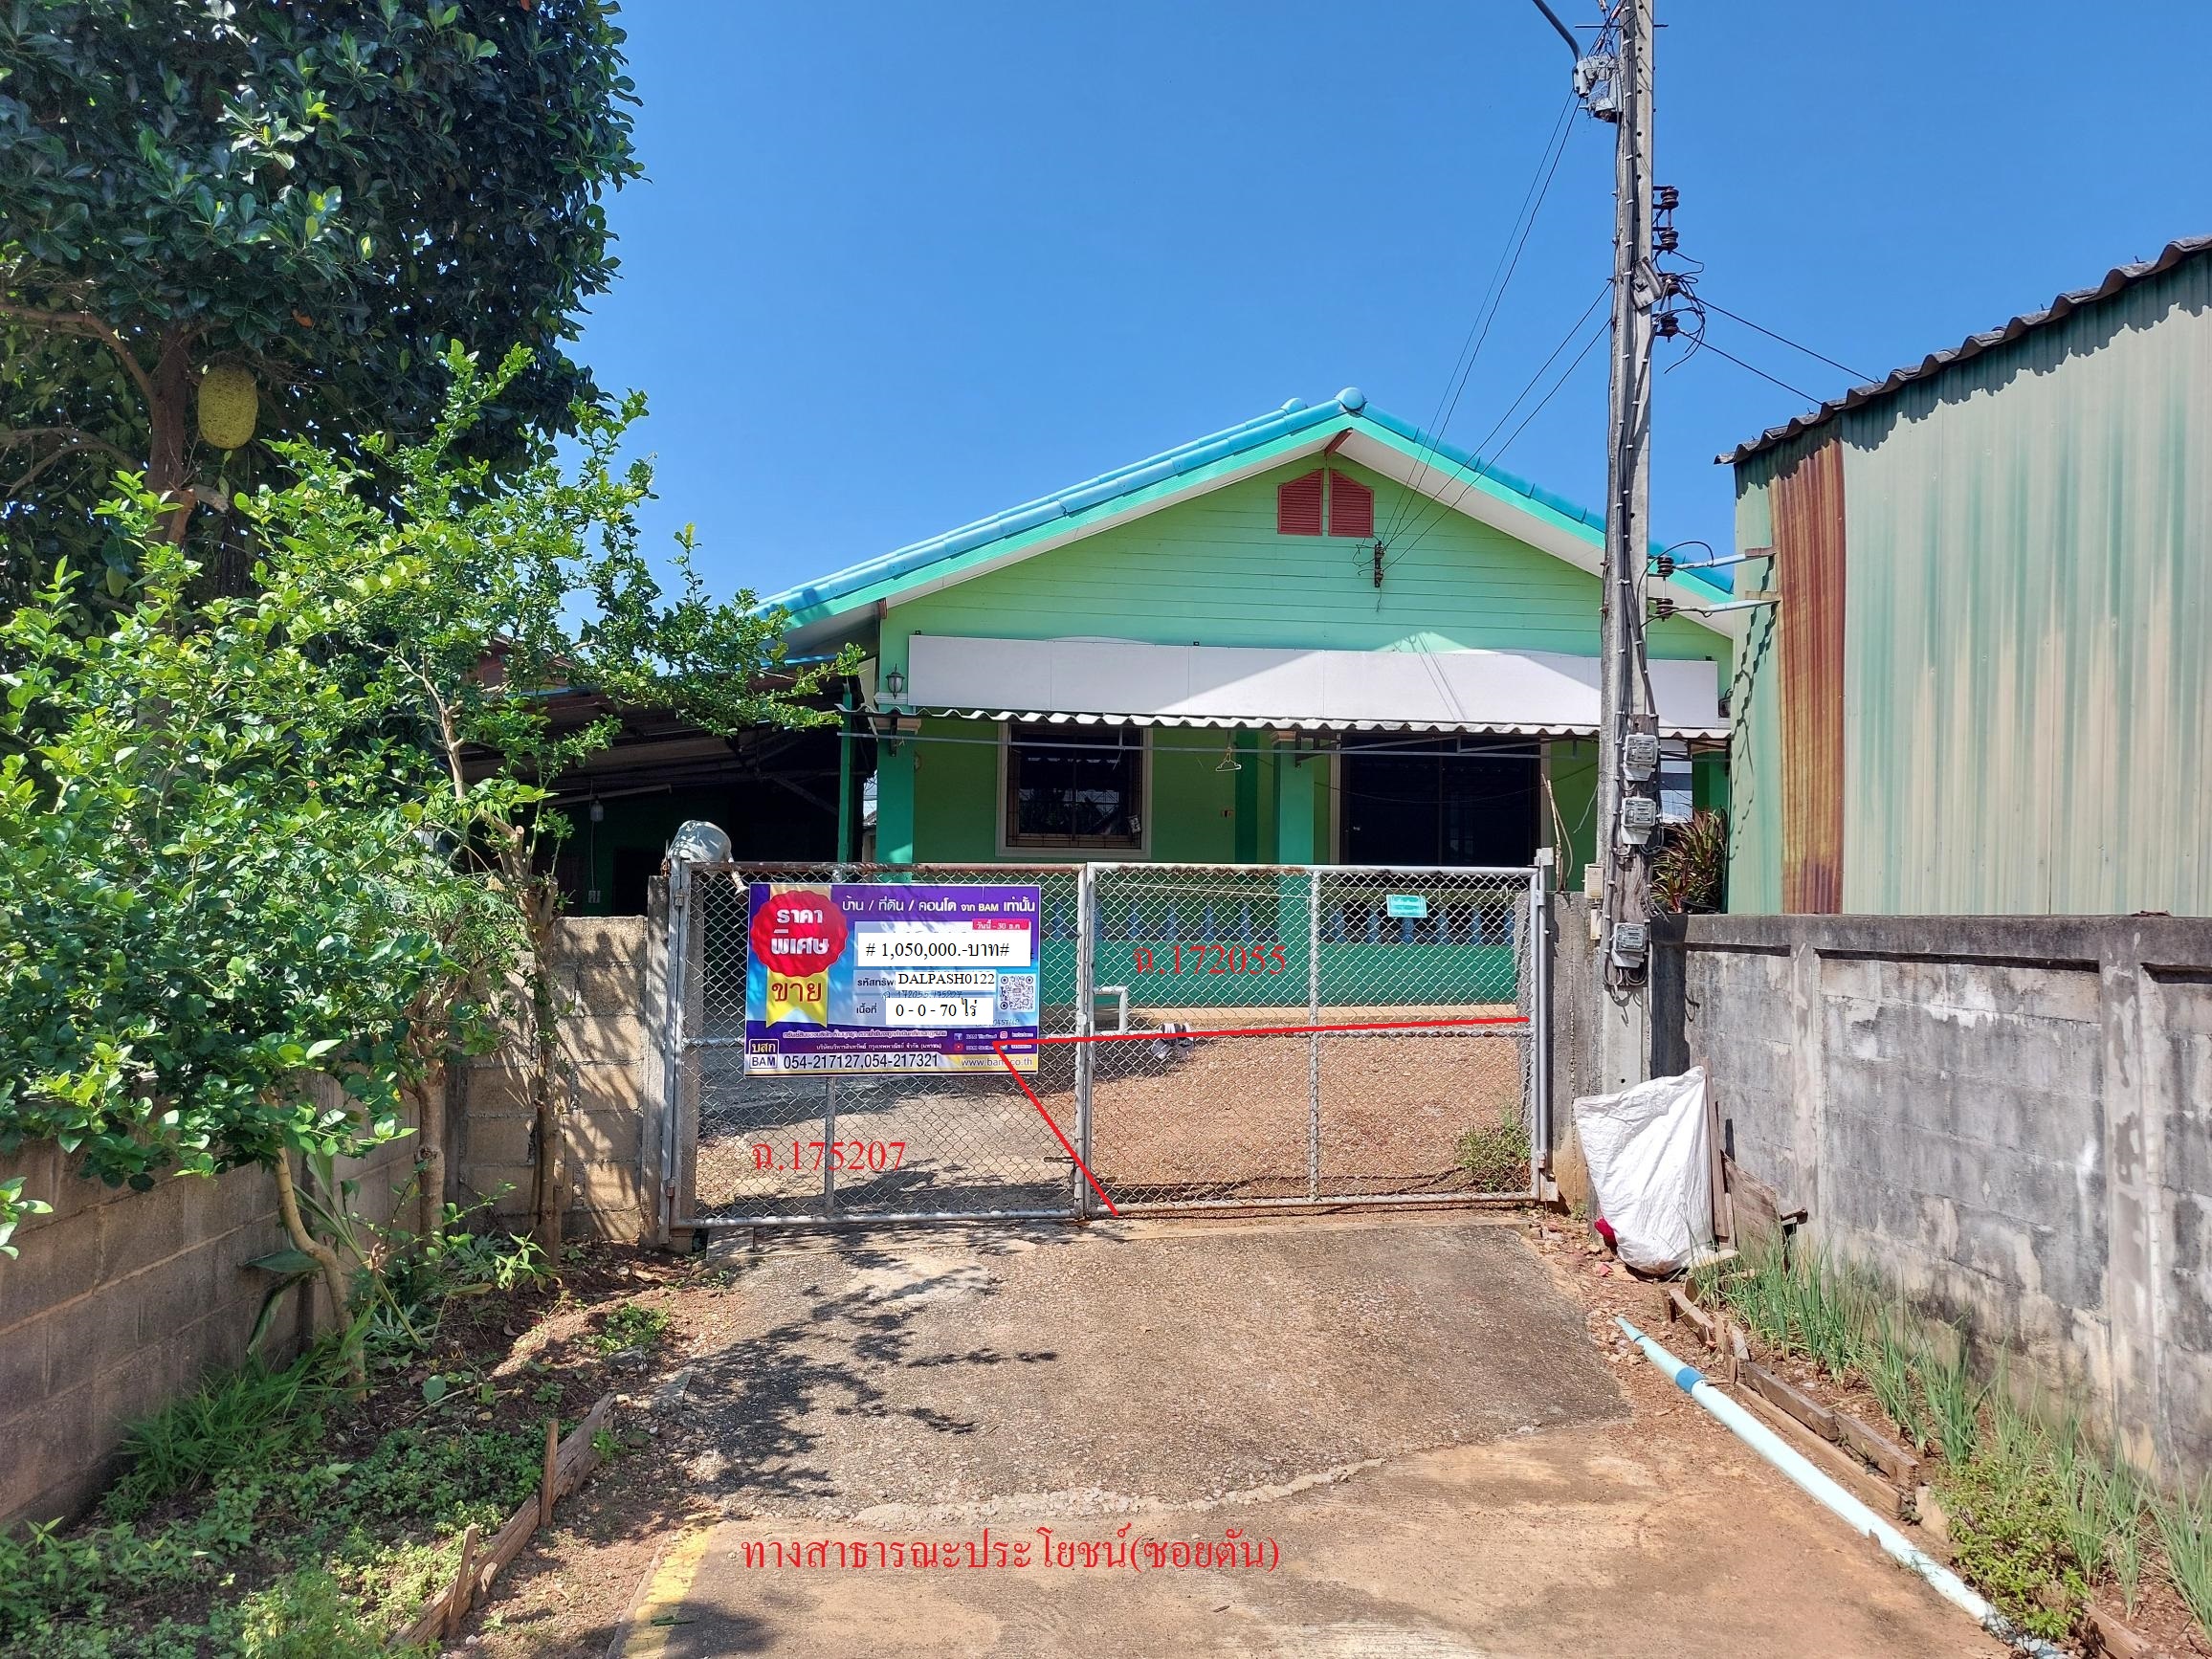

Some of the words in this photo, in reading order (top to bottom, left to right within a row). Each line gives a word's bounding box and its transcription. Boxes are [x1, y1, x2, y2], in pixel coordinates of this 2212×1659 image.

[842, 897, 864, 912] บ้าน
[878, 896, 904, 912] ที่ดิน
[918, 898, 957, 912] คอนโด
[961, 903, 975, 912] จาก
[978, 903, 999, 912] BAM
[1004, 896, 1035, 912] เท่านั้น
[776, 908, 823, 924] ราคา
[770, 928, 830, 955] พิเศษ
[857, 977, 896, 988] รหัสทรัพ
[771, 981, 823, 1004] ขาย
[856, 1003, 877, 1015] เนื้อที่
[751, 1042, 776, 1053] บสก
[751, 1056, 776, 1067] BAM
[783, 1052, 940, 1071] 054-217127,054-217321
